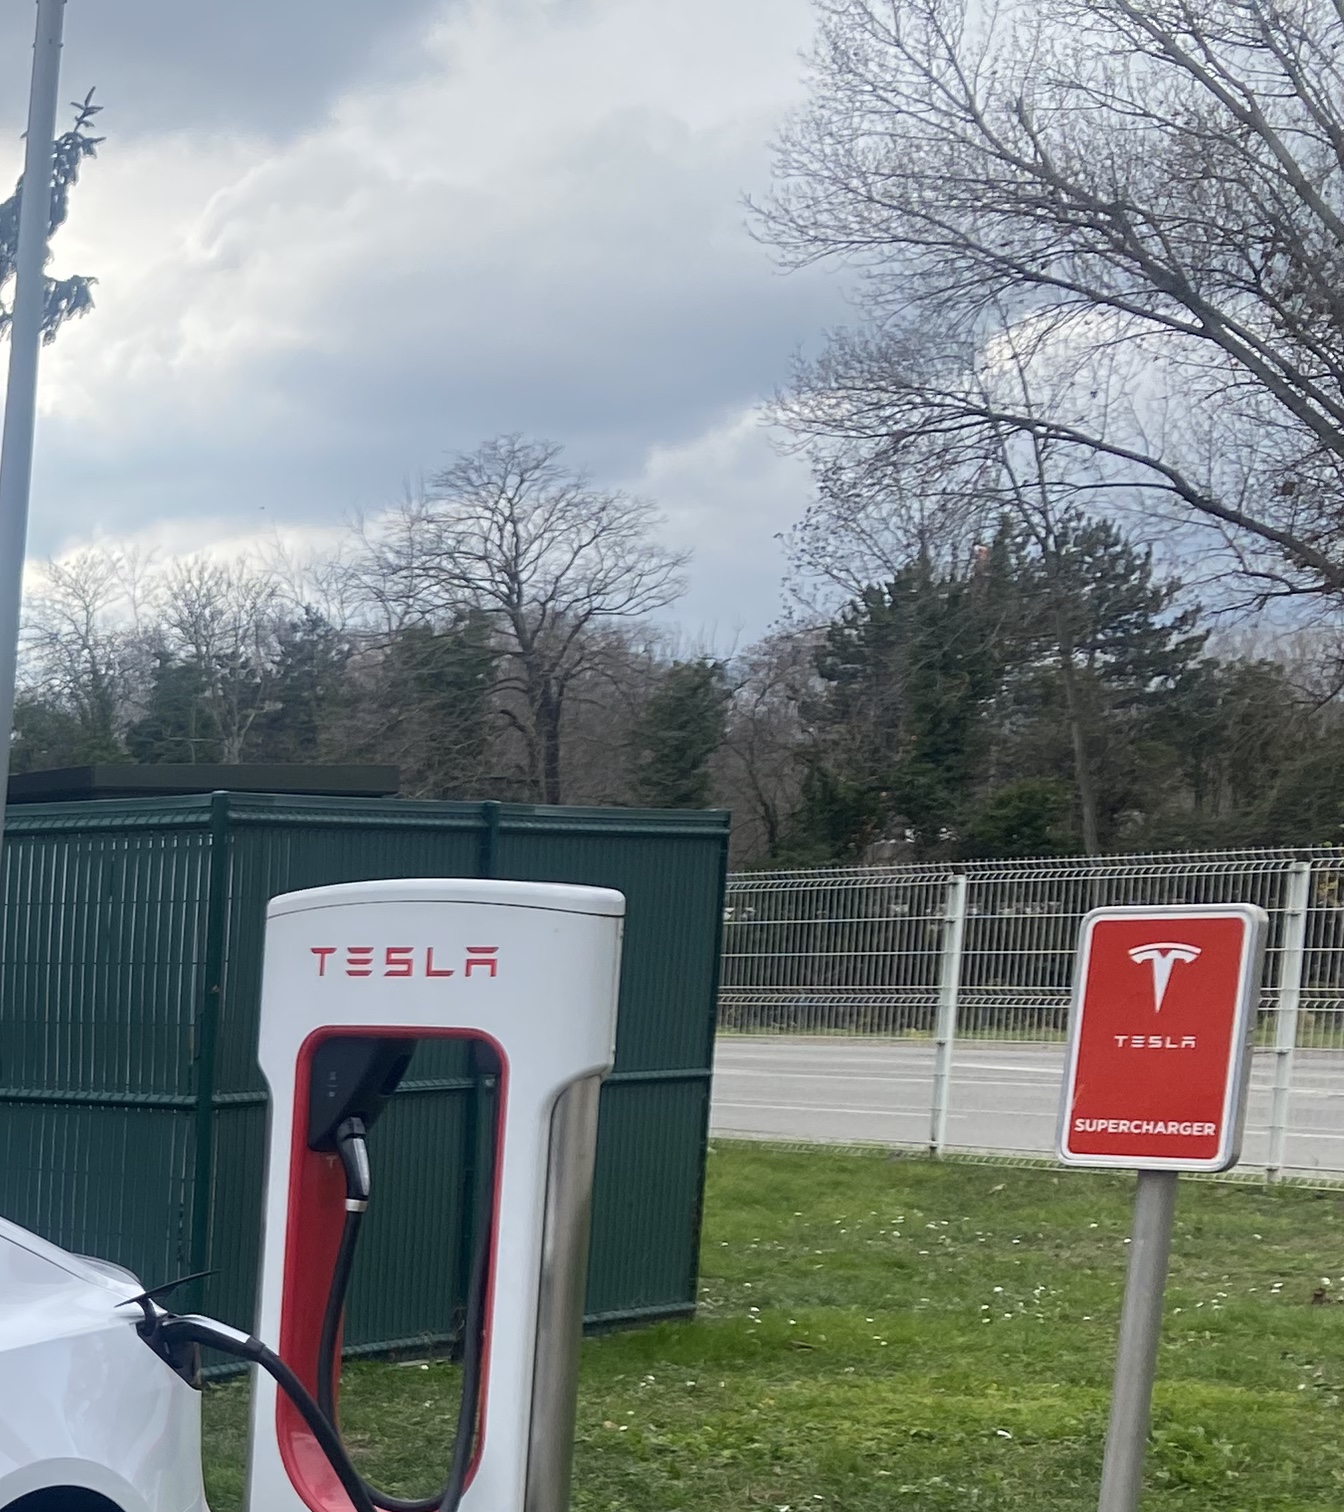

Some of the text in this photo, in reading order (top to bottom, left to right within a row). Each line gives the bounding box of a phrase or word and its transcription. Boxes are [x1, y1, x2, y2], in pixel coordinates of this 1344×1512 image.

[310, 945, 500, 978] TESLA
[1114, 1034, 1197, 1049] TESLA
[1074, 1117, 1217, 1137] SUPERCHARGER
